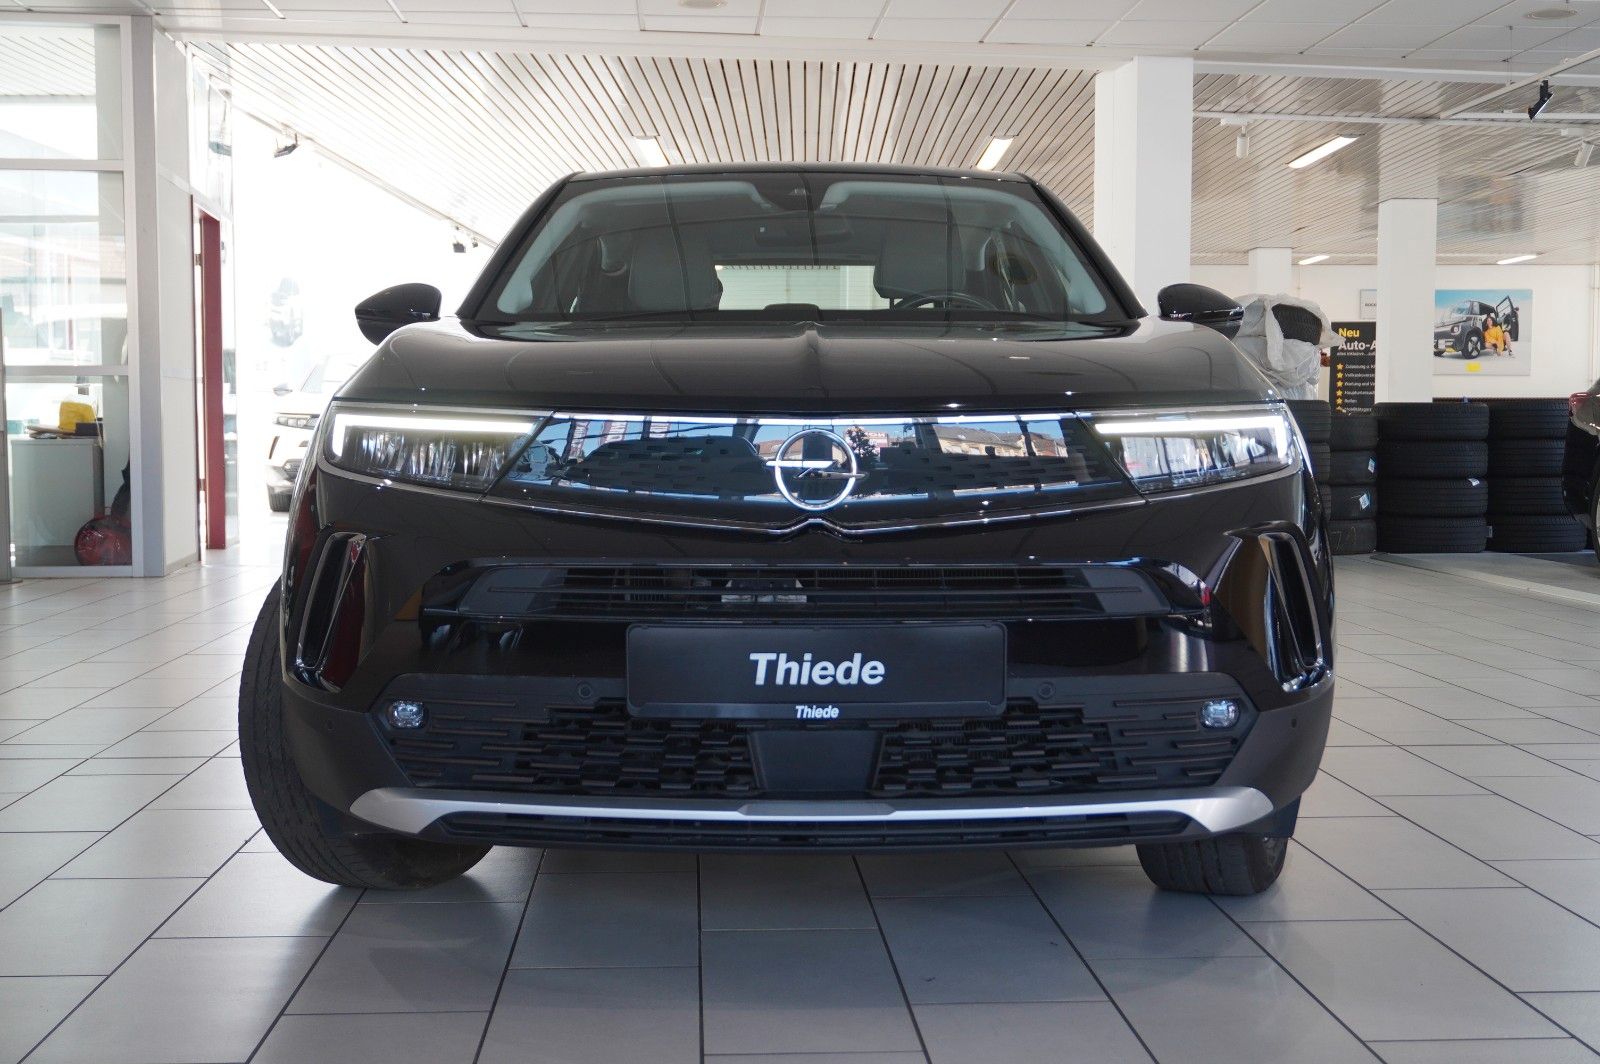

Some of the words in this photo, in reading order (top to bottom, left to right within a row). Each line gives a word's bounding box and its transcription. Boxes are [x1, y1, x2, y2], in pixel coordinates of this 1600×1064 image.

[1338, 327, 1360, 338] Neu
[749, 652, 886, 686] Thiede
[795, 705, 840, 719] Thiede
